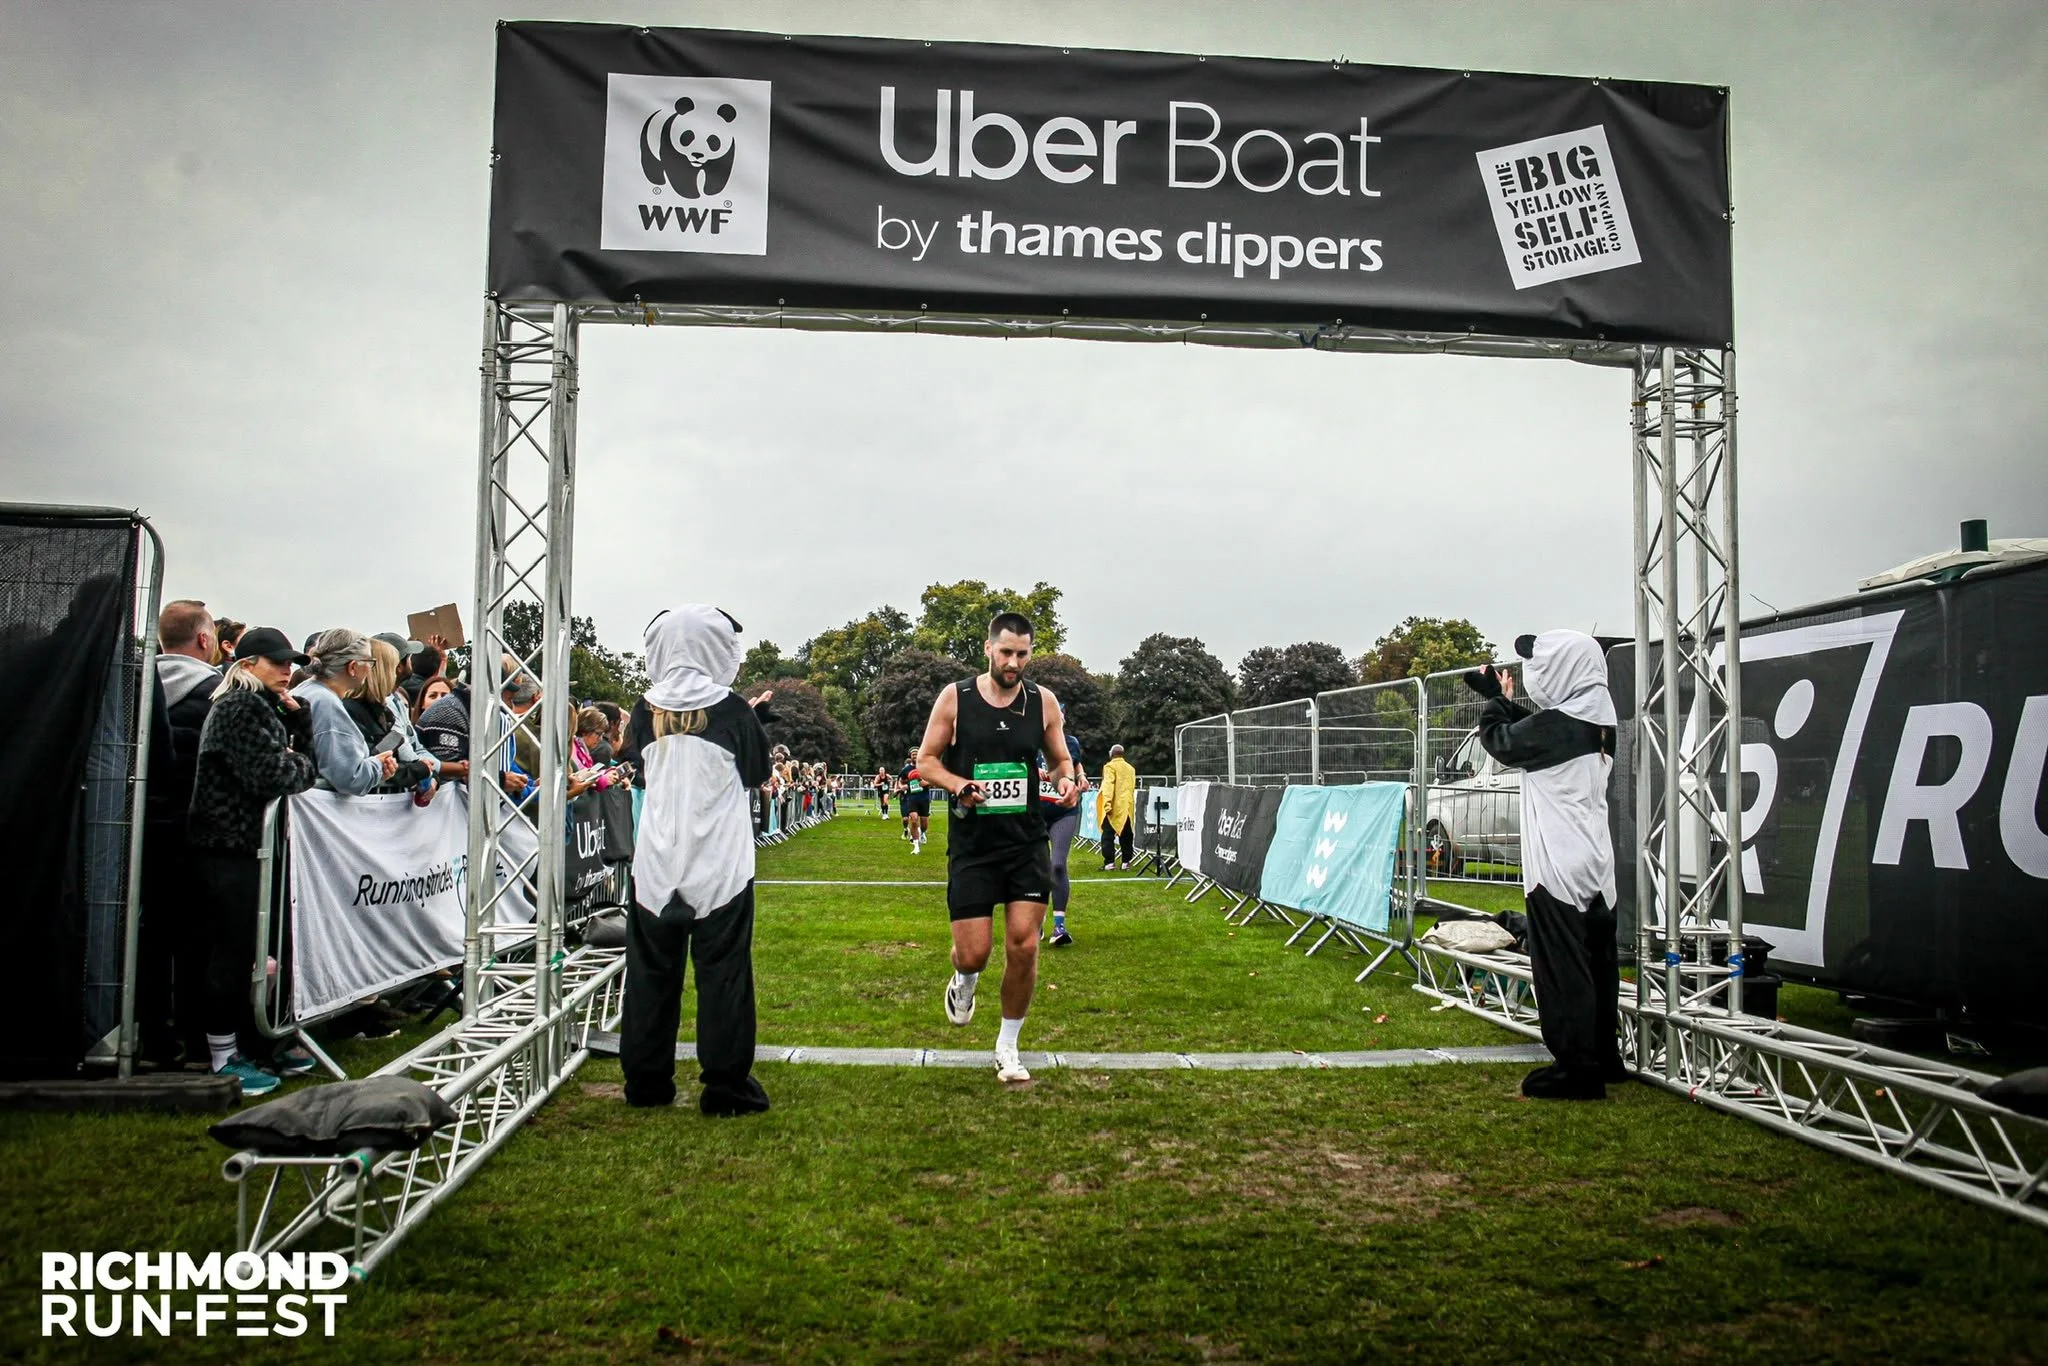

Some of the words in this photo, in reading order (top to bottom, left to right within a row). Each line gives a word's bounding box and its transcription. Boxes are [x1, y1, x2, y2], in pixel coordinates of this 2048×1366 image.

[879, 85, 1137, 186] Uber
[1168, 100, 1382, 197] Boat
[1495, 161, 1517, 198] THE
[1514, 145, 1602, 194] BIG
[637, 203, 734, 235] WWF
[1506, 184, 1592, 219] YELLOW
[1593, 182, 1622, 252] COMPANY
[877, 204, 940, 262] by
[956, 213, 1163, 263] thames
[1176, 221, 1384, 280] clippers
[1514, 204, 1598, 250] SELF
[1522, 237, 1609, 272] STORAGE
[352, 871, 426, 908] Running
[425, 862, 454, 897] strides
